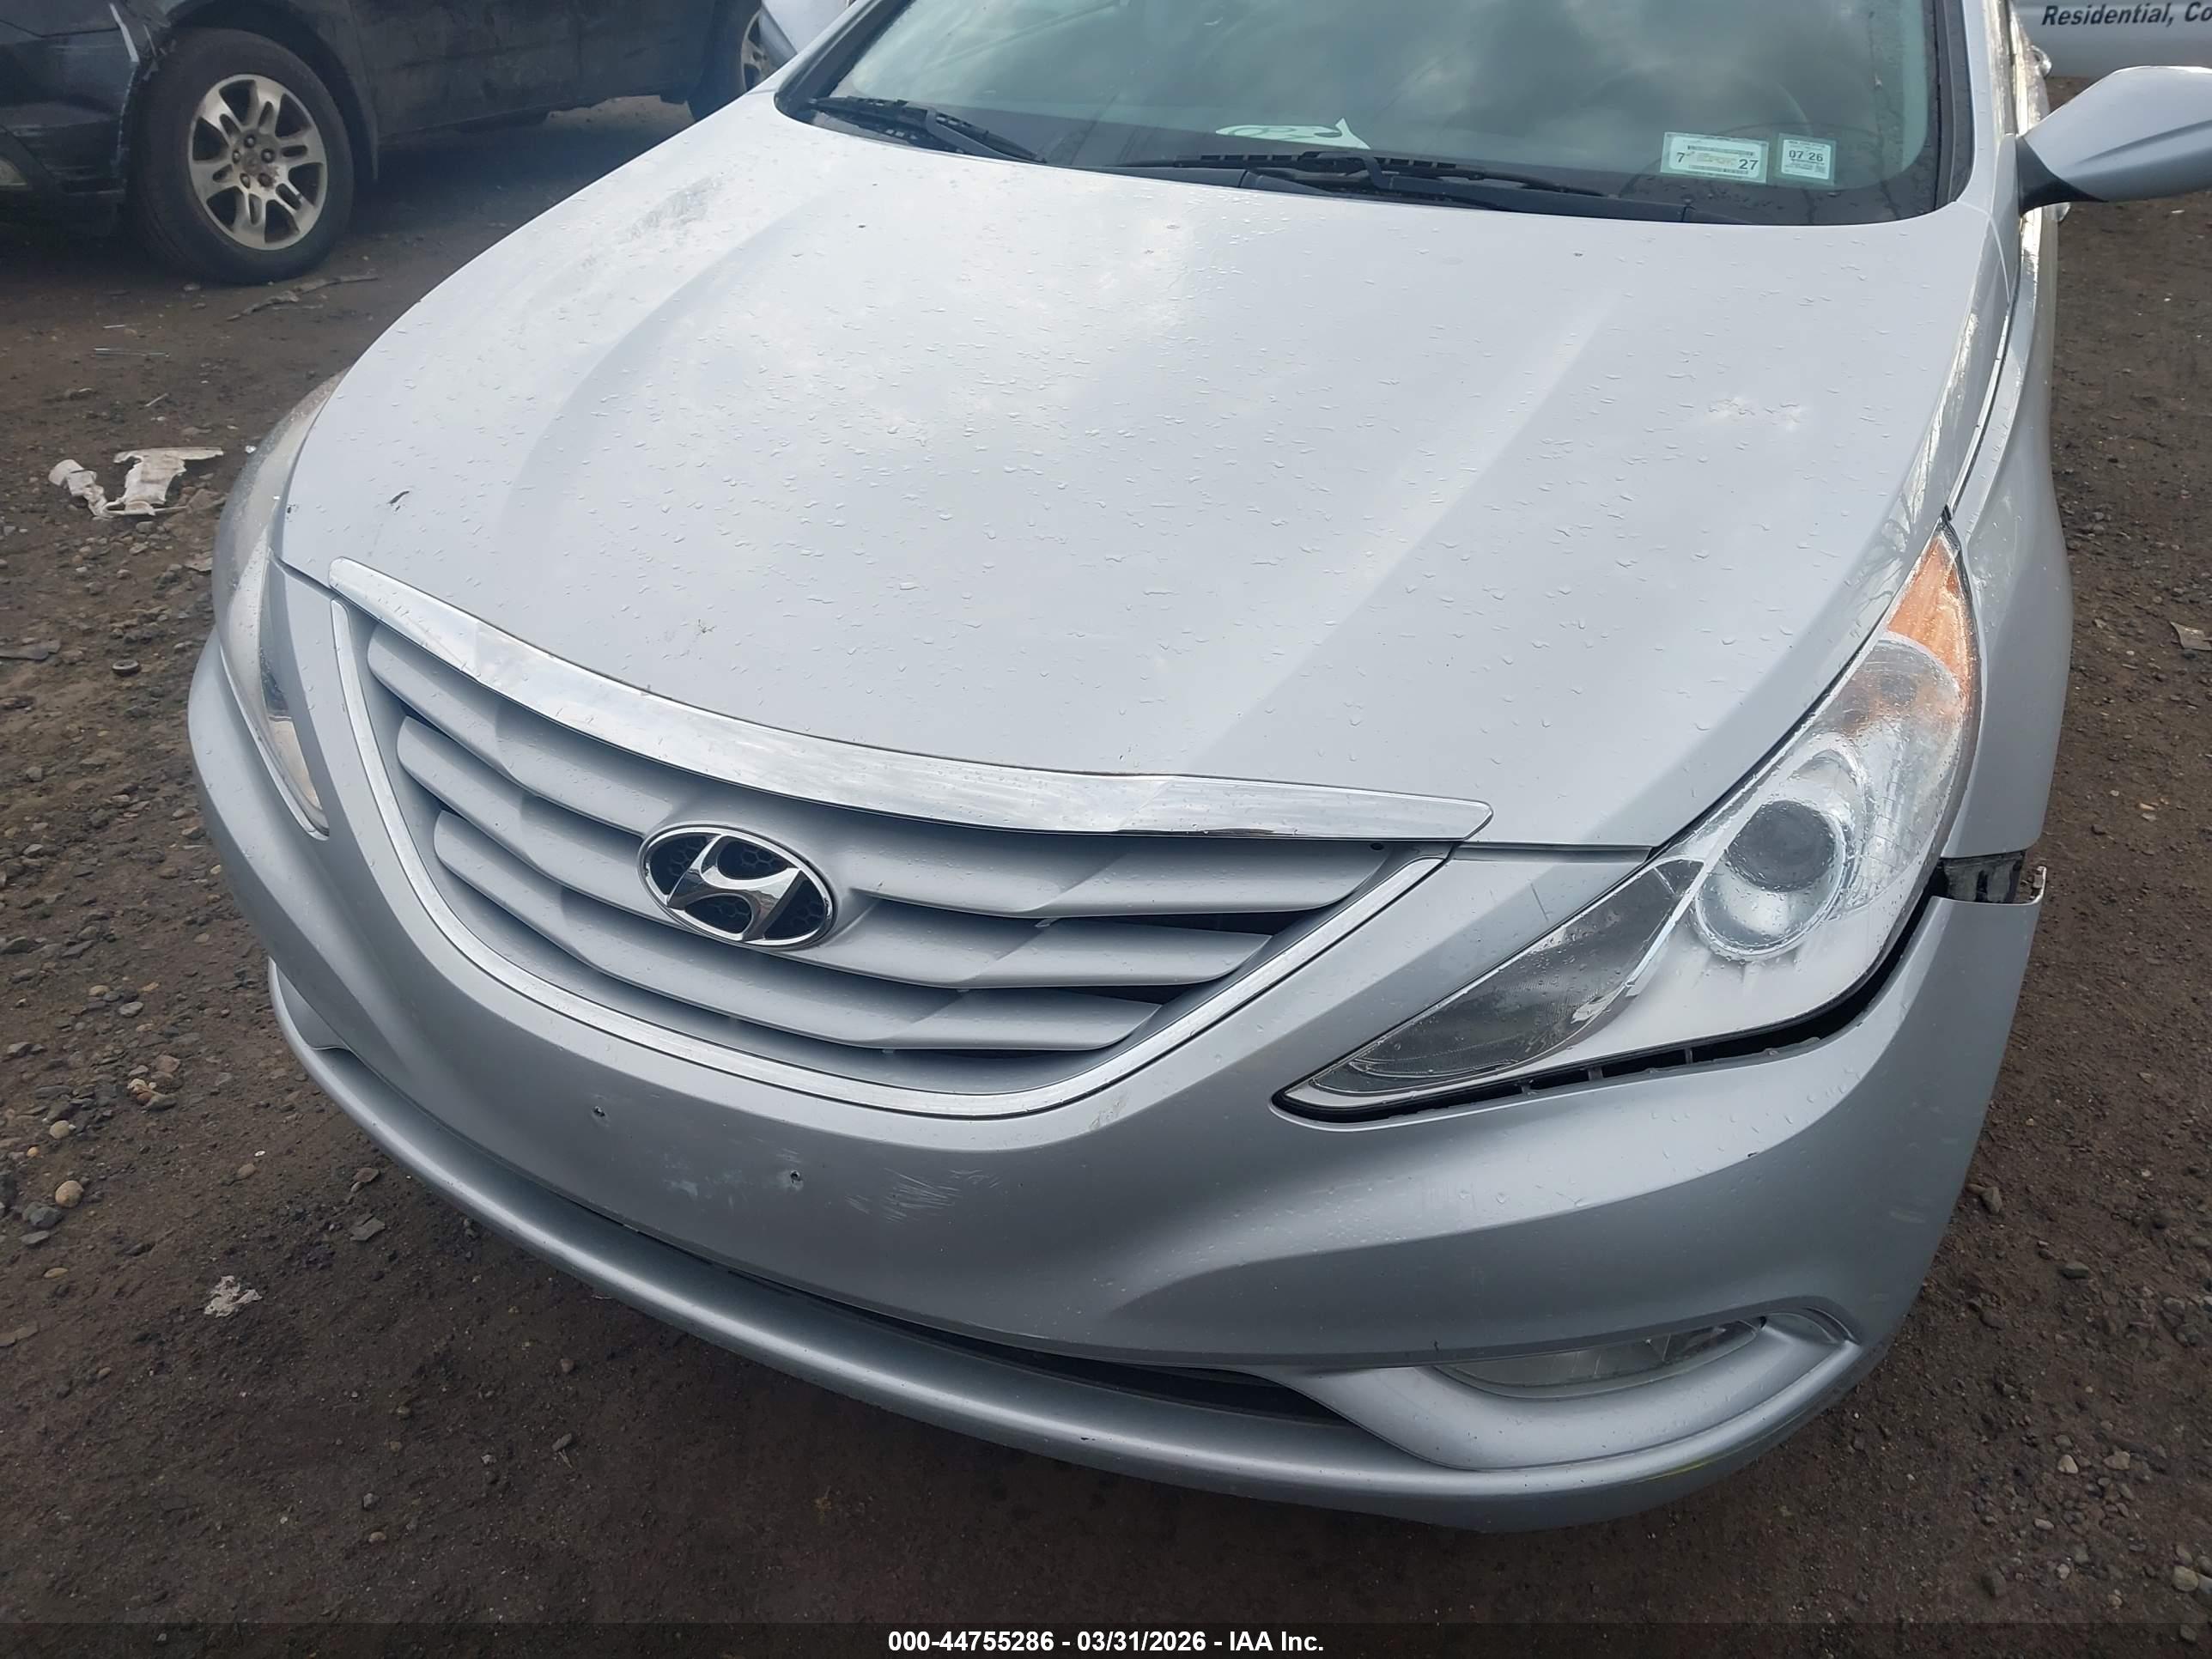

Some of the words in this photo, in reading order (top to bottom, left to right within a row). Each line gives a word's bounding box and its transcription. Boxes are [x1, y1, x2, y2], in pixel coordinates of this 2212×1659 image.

[2041, 2, 2173, 27] Residential,
[1676, 152, 1686, 163] 7
[1738, 159, 1759, 170] 27
[1789, 150, 1804, 159] 07
[1808, 152, 1824, 162] 26
